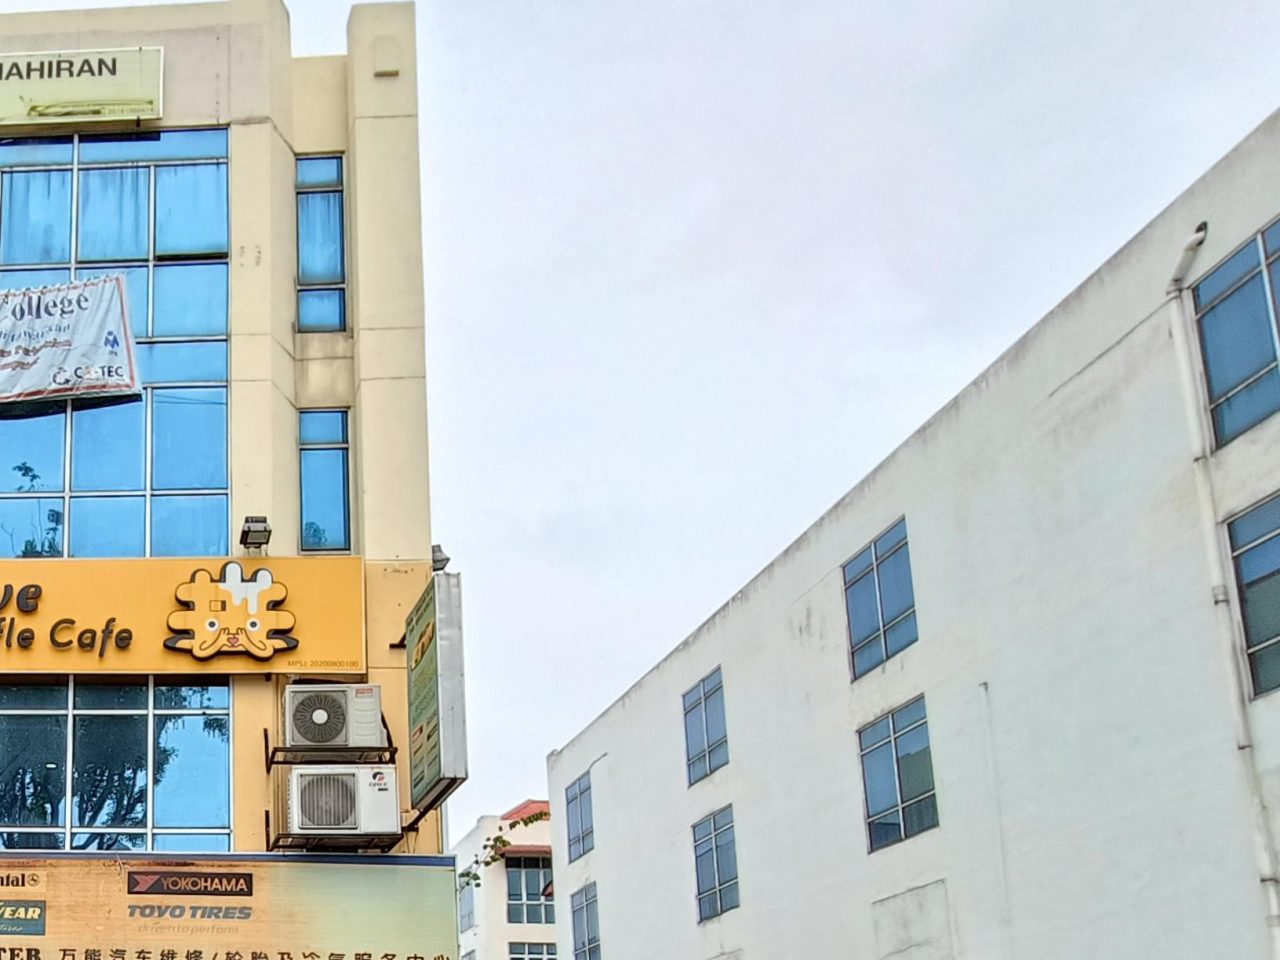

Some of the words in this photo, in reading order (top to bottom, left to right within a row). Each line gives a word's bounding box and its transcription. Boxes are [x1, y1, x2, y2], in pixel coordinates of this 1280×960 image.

[49, 617, 134, 658] Cafe
[161, 876, 249, 892] YOKOHAMA
[128, 904, 186, 918] TOYO
[189, 905, 253, 920] TIRES
